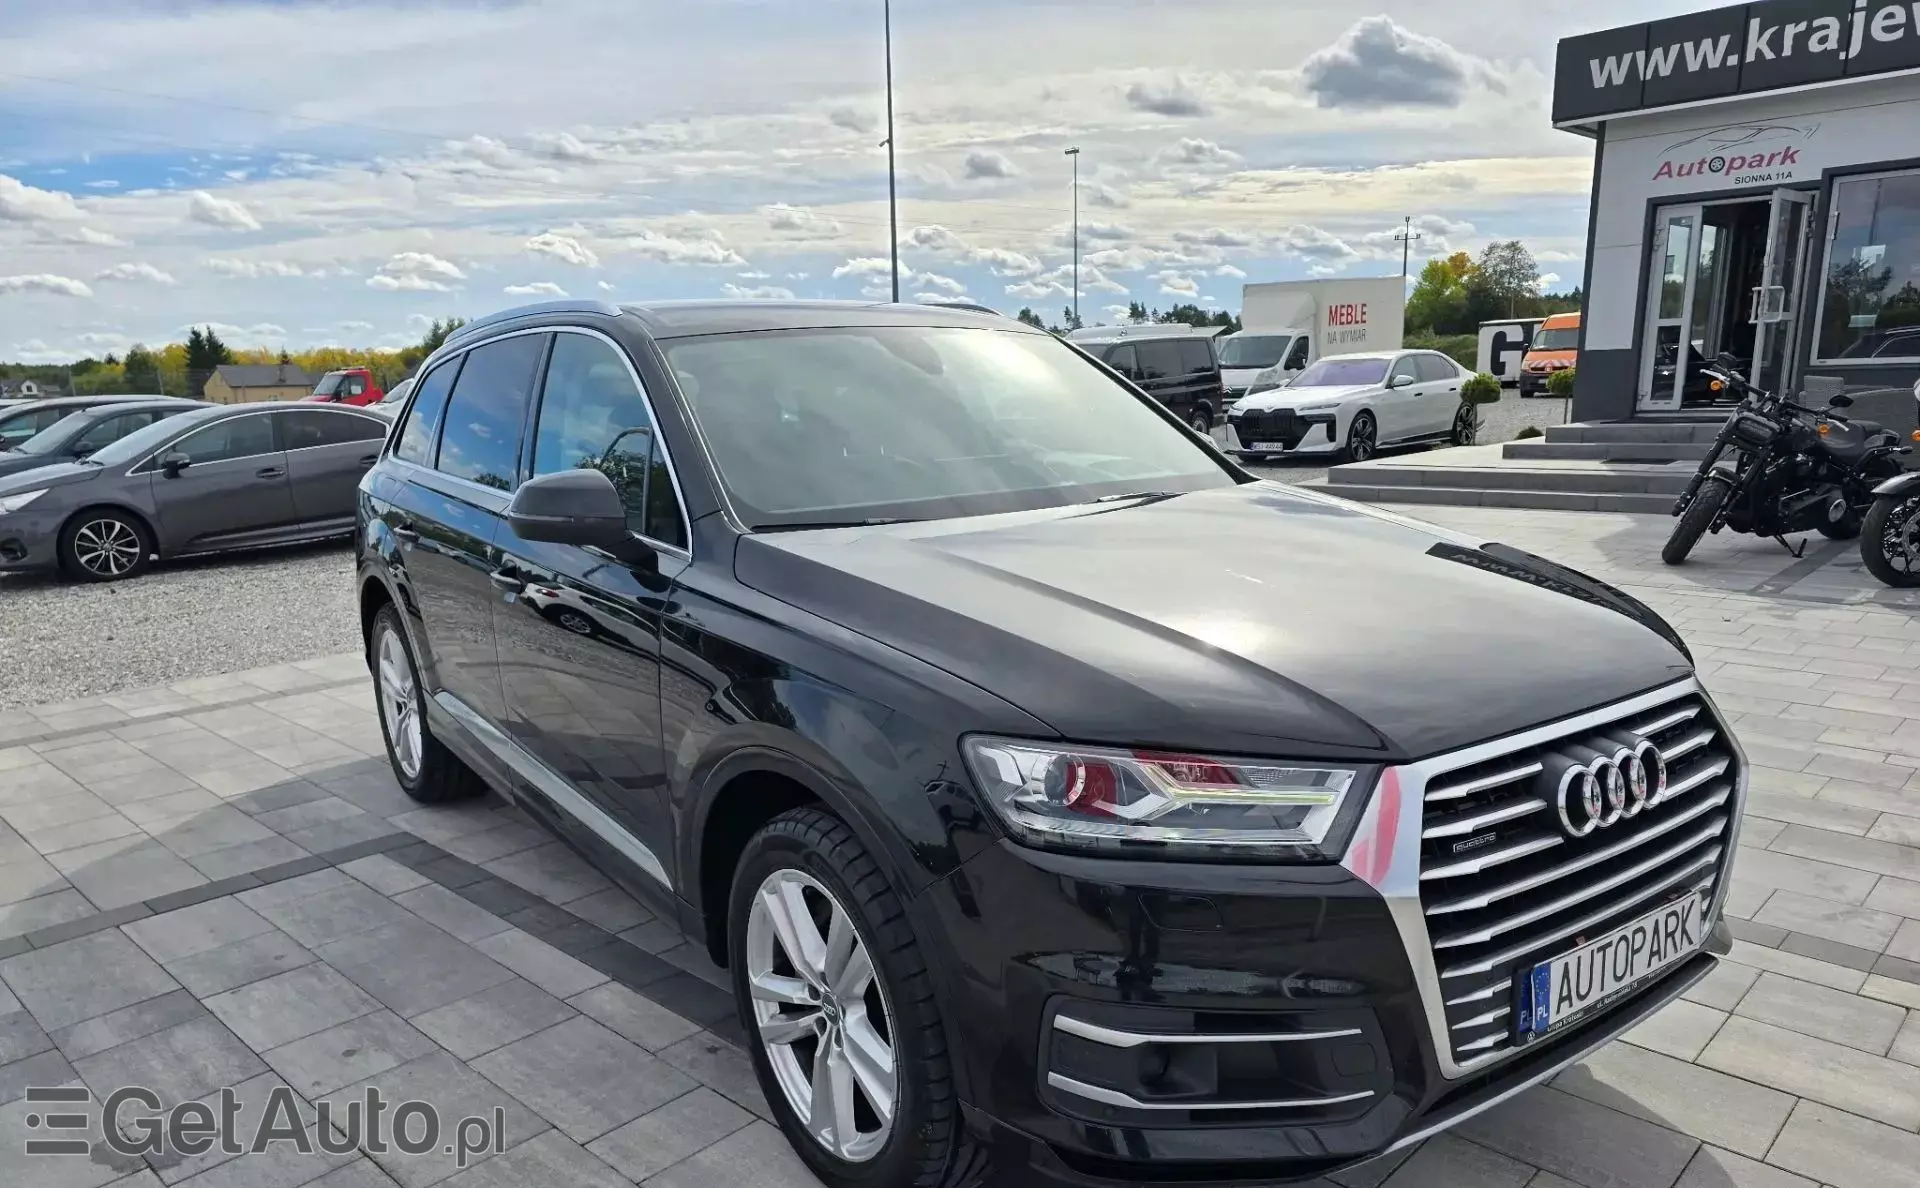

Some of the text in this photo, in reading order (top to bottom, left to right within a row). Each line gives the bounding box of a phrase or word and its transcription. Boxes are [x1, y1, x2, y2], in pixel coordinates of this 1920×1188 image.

[1589, 0, 1920, 89] www.kraje
[1734, 171, 1793, 185] SIONNA 11A
[1328, 303, 1368, 326] MEBLE
[1327, 330, 1338, 344] NA
[1555, 898, 1696, 1016] AUTOPARK
[1537, 1004, 1549, 1021] PL
